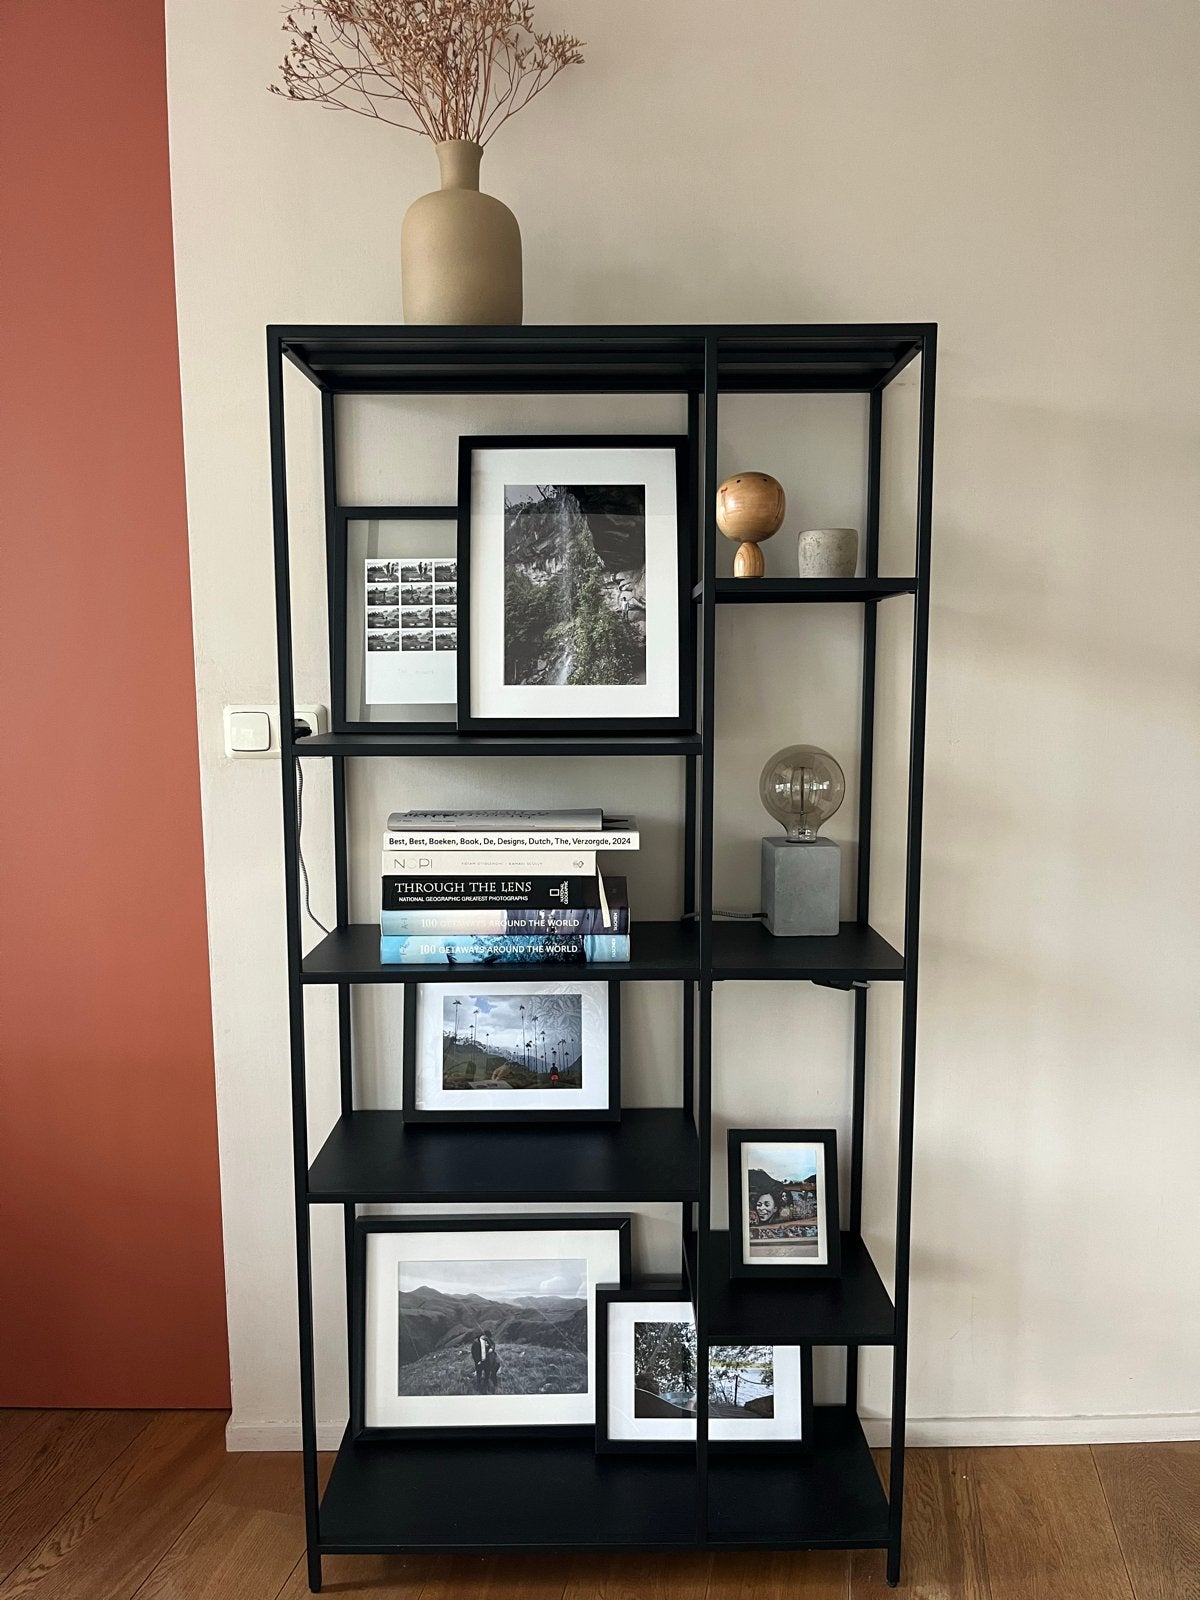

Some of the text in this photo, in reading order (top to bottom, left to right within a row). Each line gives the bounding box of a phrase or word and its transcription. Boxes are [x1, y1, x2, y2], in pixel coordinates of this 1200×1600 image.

[389, 837, 631, 847] Best, Best, Boeken, Book, De, Designs, Dutch, The, Verzorgde, 2024
[394, 858, 432, 869] NOPI
[395, 881, 532, 893] THROUGH THE LENS
[421, 918, 438, 927] 100
[440, 919, 488, 927] GETAWAYS
[420, 944, 578, 954] 100 GETAWAYS AROUND THE WORLD
